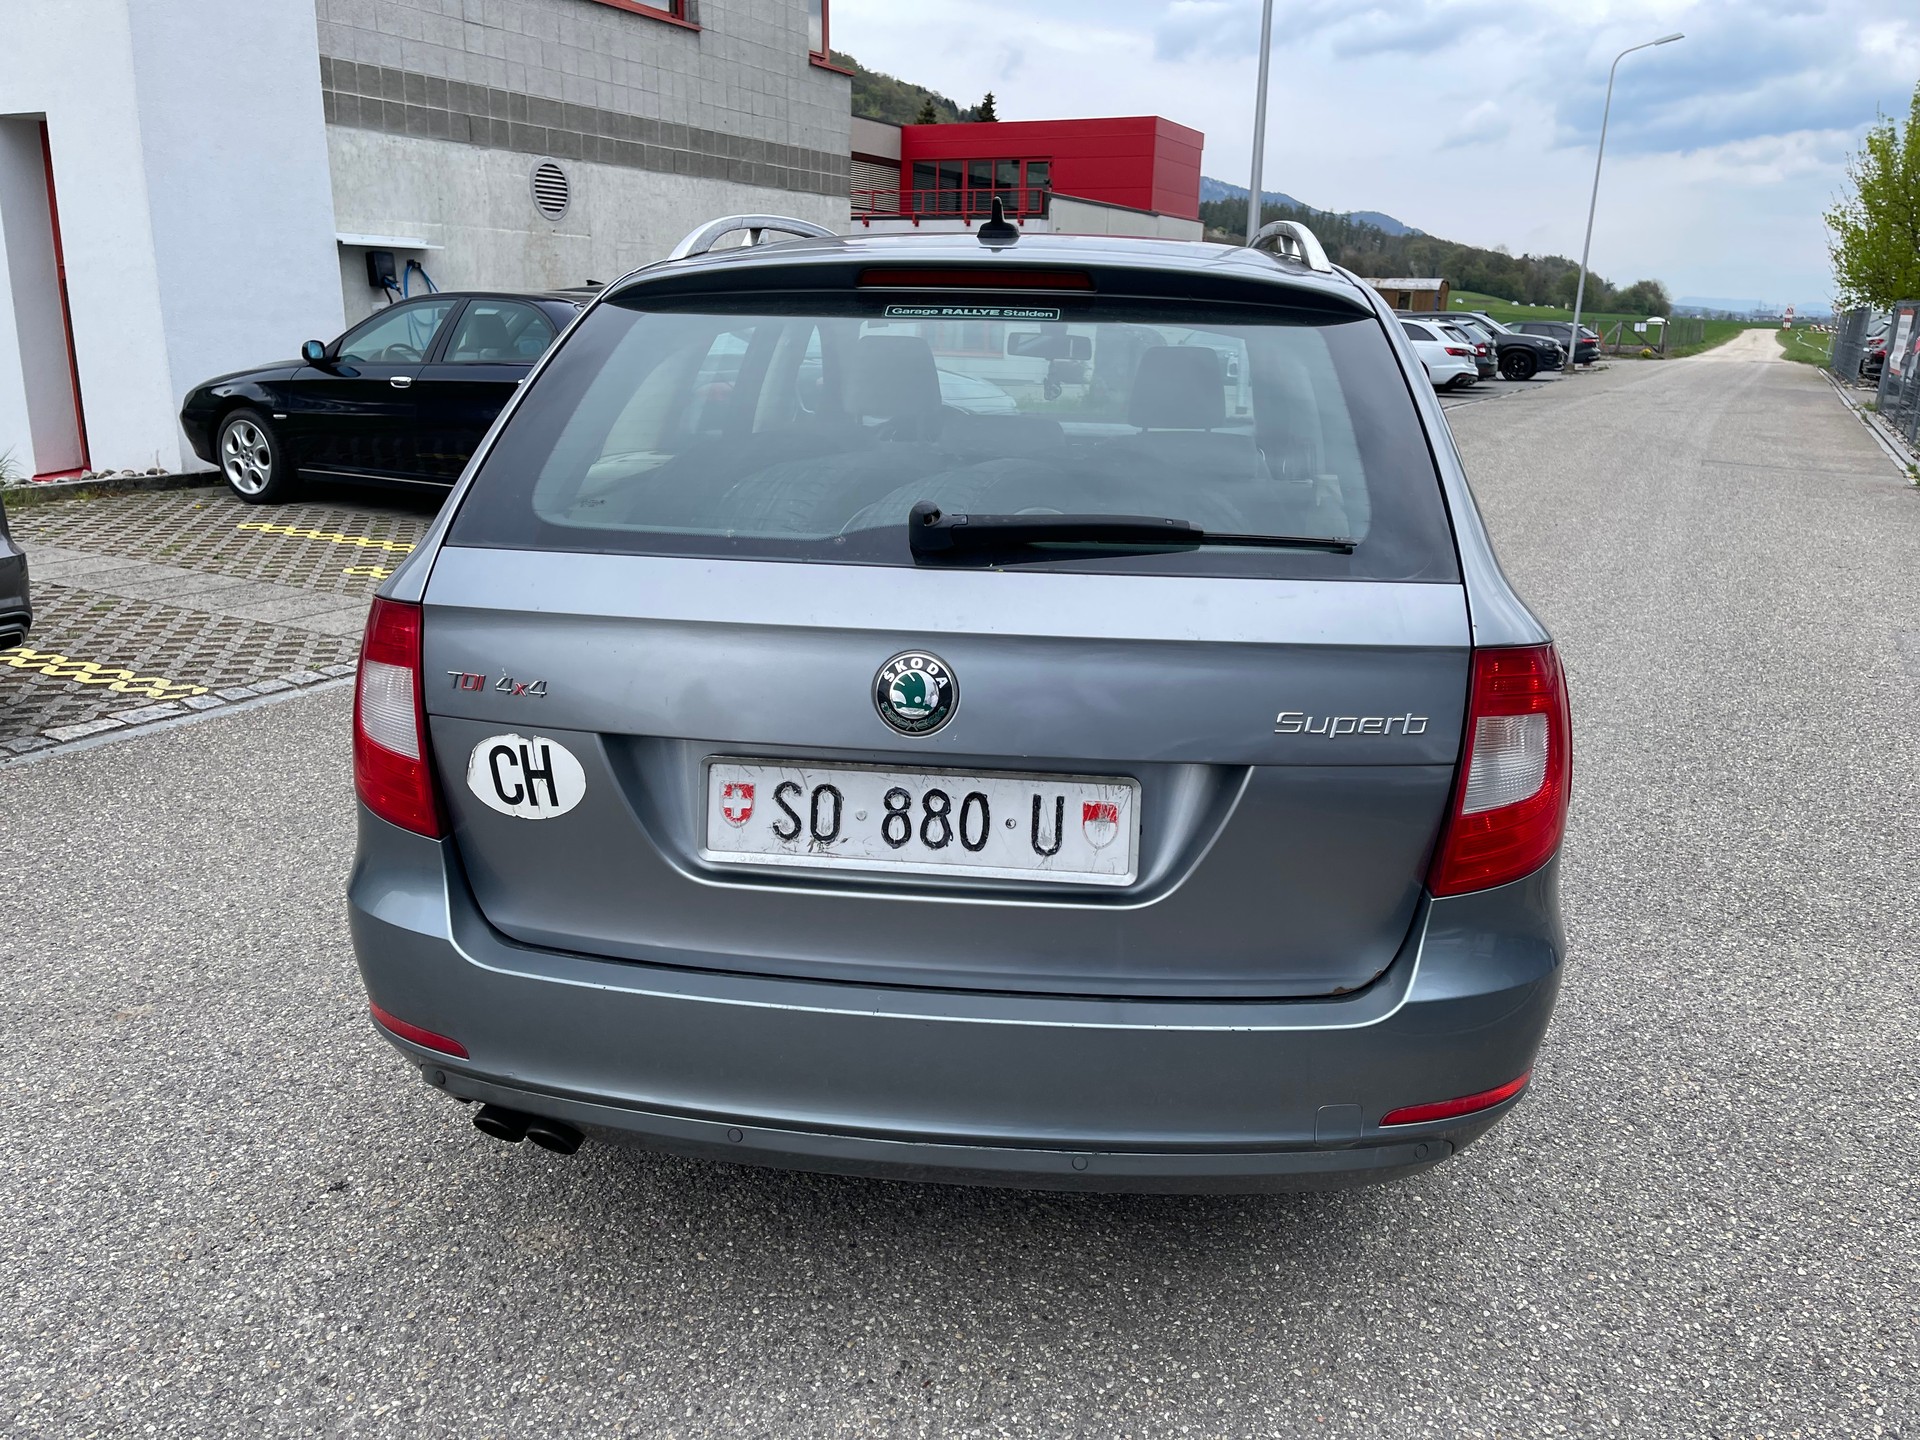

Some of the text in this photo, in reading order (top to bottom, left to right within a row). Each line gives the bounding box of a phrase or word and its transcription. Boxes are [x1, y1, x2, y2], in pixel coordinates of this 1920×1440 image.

[891, 307, 1053, 318] Garage RALLYE Stalden
[447, 670, 547, 698] TDI 4x4
[1274, 711, 1429, 739] Superb
[488, 744, 559, 807] CH
[772, 780, 1065, 857] SO 880 U
